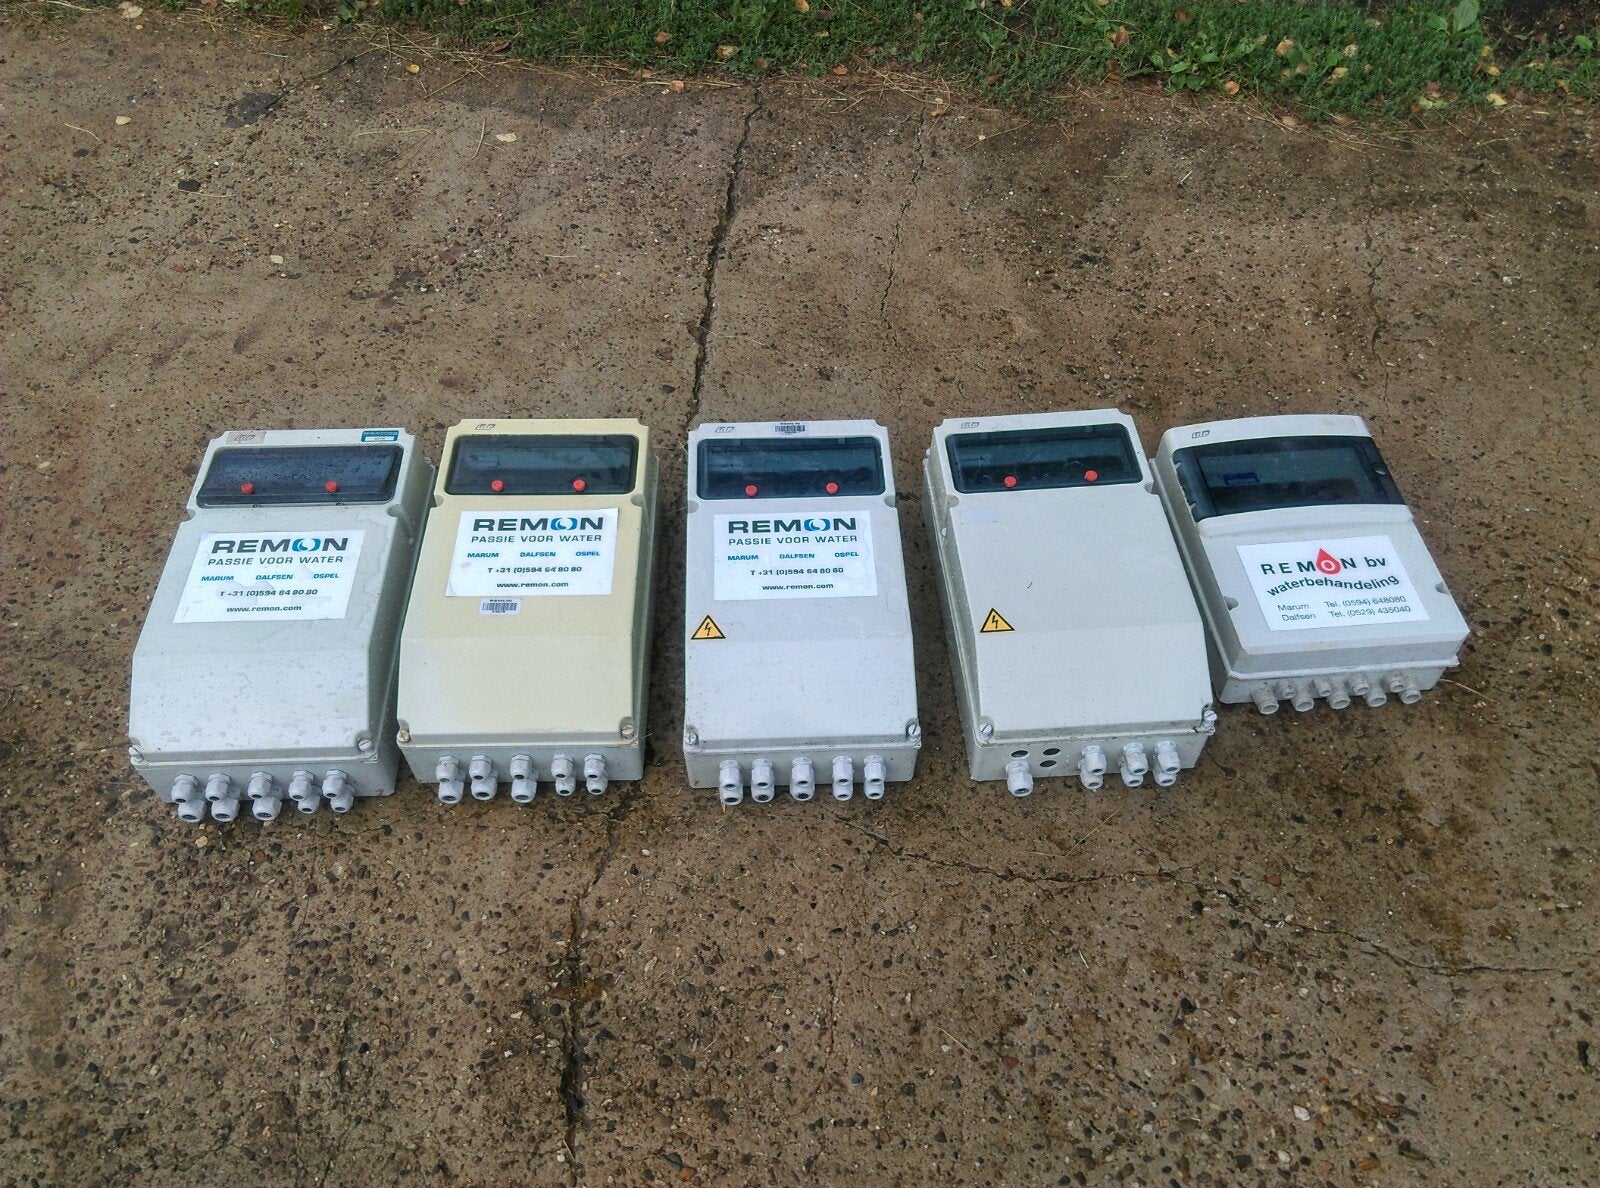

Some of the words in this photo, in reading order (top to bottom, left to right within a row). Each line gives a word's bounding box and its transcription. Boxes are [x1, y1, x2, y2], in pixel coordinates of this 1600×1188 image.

[473, 517, 604, 532] REMON
[728, 517, 857, 534] REMON
[211, 537, 349, 554] REMON
[559, 534, 602, 542] WATER
[777, 536, 810, 544] VOOR
[814, 535, 858, 543] WATER
[208, 557, 253, 566] PASSIE
[259, 557, 293, 565] VOOR
[299, 555, 344, 564] WATER
[1260, 557, 1357, 575] REMON
[1364, 556, 1387, 568] bv
[513, 566, 542, 574] (0)594
[776, 568, 804, 576] (0)594
[1266, 574, 1400, 596] waterbehandeling
[246, 589, 277, 597] (0)594
[1277, 603, 1310, 611] Marum
[1324, 600, 1341, 608] Tel.
[1342, 598, 1371, 607] (0594)
[1372, 595, 1406, 604] 648080
[1281, 612, 1317, 622] Dalfsen
[1329, 610, 1346, 618] Tel.
[1347, 608, 1376, 617] (0529)
[1377, 605, 1411, 614] 435040
